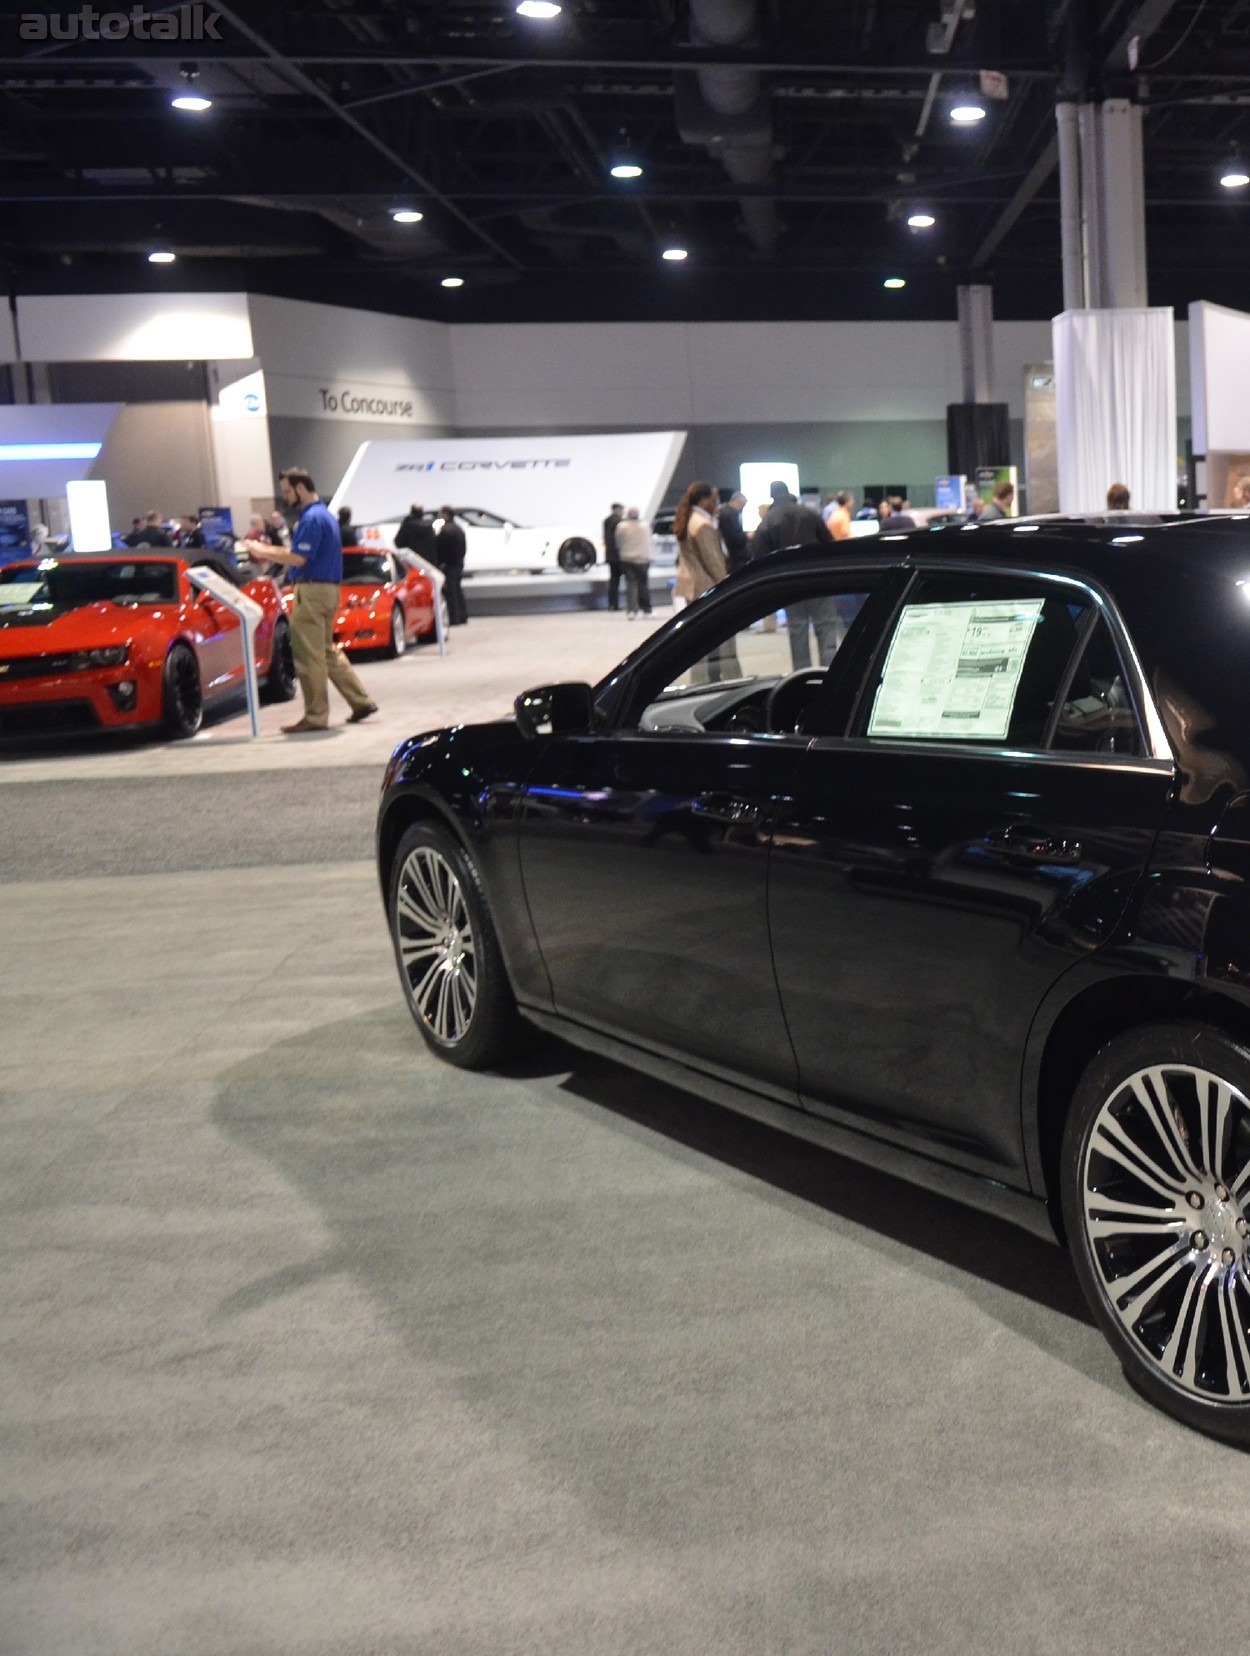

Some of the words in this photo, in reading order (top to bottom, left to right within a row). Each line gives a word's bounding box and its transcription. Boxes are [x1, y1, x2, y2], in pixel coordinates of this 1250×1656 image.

[319, 388, 338, 412] To
[341, 390, 413, 417] Concourse
[440, 458, 571, 471] CORVETTE
